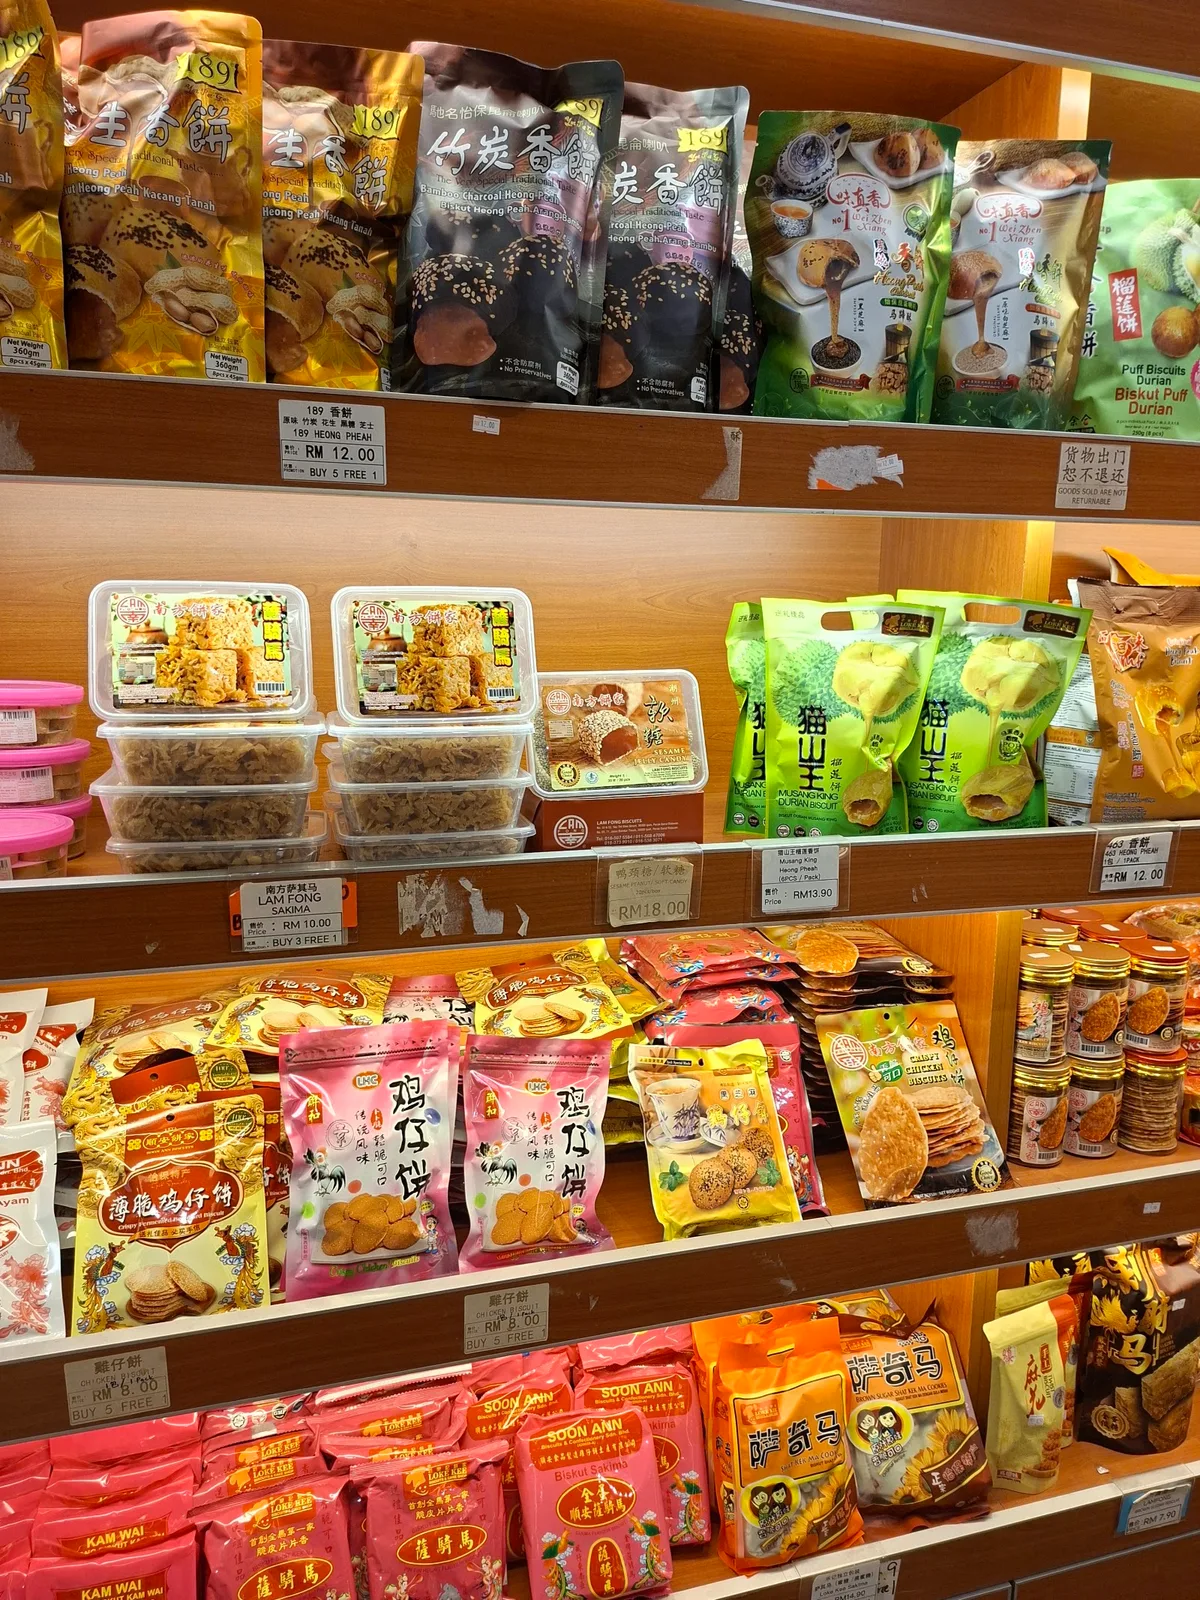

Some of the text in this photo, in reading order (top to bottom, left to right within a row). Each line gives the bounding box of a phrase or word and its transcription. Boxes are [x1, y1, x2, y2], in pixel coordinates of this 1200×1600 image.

[361, 108, 394, 134] 189
[177, 158, 203, 171] Taste
[67, 166, 127, 179] Heong Peah
[476, 174, 553, 187] Special Traditional
[78, 180, 215, 211] Heong Peah Kacang Tanah
[284, 190, 309, 202] Peah
[420, 184, 560, 206] Bamboo Charcoal Heong Peah
[440, 201, 471, 213] Biskut
[474, 206, 504, 216] Heong
[533, 206, 560, 220] Arang
[852, 213, 869, 222] Wei
[263, 207, 349, 230] Heong Peah Kacang
[635, 221, 688, 233] Heong Peah
[857, 222, 887, 236] Xiang
[999, 224, 1016, 233] Wei
[638, 235, 717, 252] Peah Arang Bambu
[1003, 234, 1034, 245] Xiang
[1112, 276, 1138, 334] 榴莲饼
[13, 347, 40, 357] 360gm
[21, 340, 44, 350] Weight
[215, 360, 238, 371] 360gm
[1122, 364, 1186, 375] Puff Biscuits
[515, 366, 552, 381] Preservatives
[1136, 375, 1172, 386] Durian
[650, 386, 684, 397] Preservatives
[1115, 387, 1188, 402] Biskut Puff
[307, 406, 353, 418] 189 香餅
[1128, 401, 1173, 415] Durian
[283, 416, 374, 429] 原味 竹炭 花生 芝士
[294, 429, 372, 441] 189 HEONG PHEAH
[306, 445, 375, 462] RM 12.00
[1065, 446, 1126, 465] 货物出门
[310, 468, 367, 480] BUY 5 FREE
[1062, 465, 1125, 483] 恕不退还
[1082, 488, 1098, 496] SOLD
[1113, 489, 1126, 497] NOT
[1072, 497, 1111, 505] RETURNABLE
[653, 747, 686, 756] SESAME
[659, 755, 688, 764] CANDY
[778, 789, 839, 800] MUSANG KING
[935, 783, 958, 794] KING
[778, 797, 838, 810] DURIAN BISCUIT
[929, 792, 956, 803] BISCUIT
[1119, 847, 1158, 856] HEONG PHEAH
[1114, 871, 1127, 882] RM
[266, 883, 317, 895] 南方萨其马
[793, 888, 833, 899] RM13.90
[258, 893, 321, 906] LAM FONG
[271, 905, 311, 915] SAKIMA
[619, 901, 686, 920] RM18.00
[283, 918, 331, 930] RM 10.00
[272, 935, 329, 947] BUY 3 FREE
[909, 1052, 940, 1063] CRISPY
[905, 1063, 944, 1075] CHICKEN
[908, 1074, 948, 1086] BISCUITS
[390, 1075, 431, 1200] 鸡仔饼
[556, 1086, 591, 1199] 鸡仔饼
[109, 1181, 233, 1223] 薄脆鸡仔饼
[489, 1290, 529, 1307] 雞仔餅
[476, 1303, 539, 1319] CHICKEN BISCUIT
[485, 1314, 540, 1333] RM 8.00
[466, 1330, 534, 1350] BUY 5 FREE
[94, 1355, 142, 1374] 雞仔餅
[845, 1345, 942, 1394] 萨奇马
[80, 1367, 155, 1387] CHICKEN BISCUIT
[92, 1379, 158, 1402] RM 8.00
[601, 1380, 673, 1398] SOON ANN
[927, 1382, 948, 1391] COOKIES
[72, 1397, 153, 1420] BUY 5 FREE
[484, 1391, 554, 1413] SOON ANN
[384, 1417, 422, 1432] LOKE KEE
[547, 1418, 623, 1443] SOON ANN
[748, 1410, 842, 1469] 萨奇马
[261, 1441, 301, 1458] LOKE KEE
[253, 1463, 294, 1480] LOKE KEE
[428, 1466, 468, 1481] LOKE KEE
[554, 1460, 628, 1481] Biskut Sakima
[270, 1496, 313, 1513] LOKE KEE
[1143, 1510, 1177, 1525] RM 7.90
[86, 1525, 145, 1548] KAM WAI
[81, 1579, 142, 1600] KAM WAI
[147, 1586, 164, 1597] WAI
